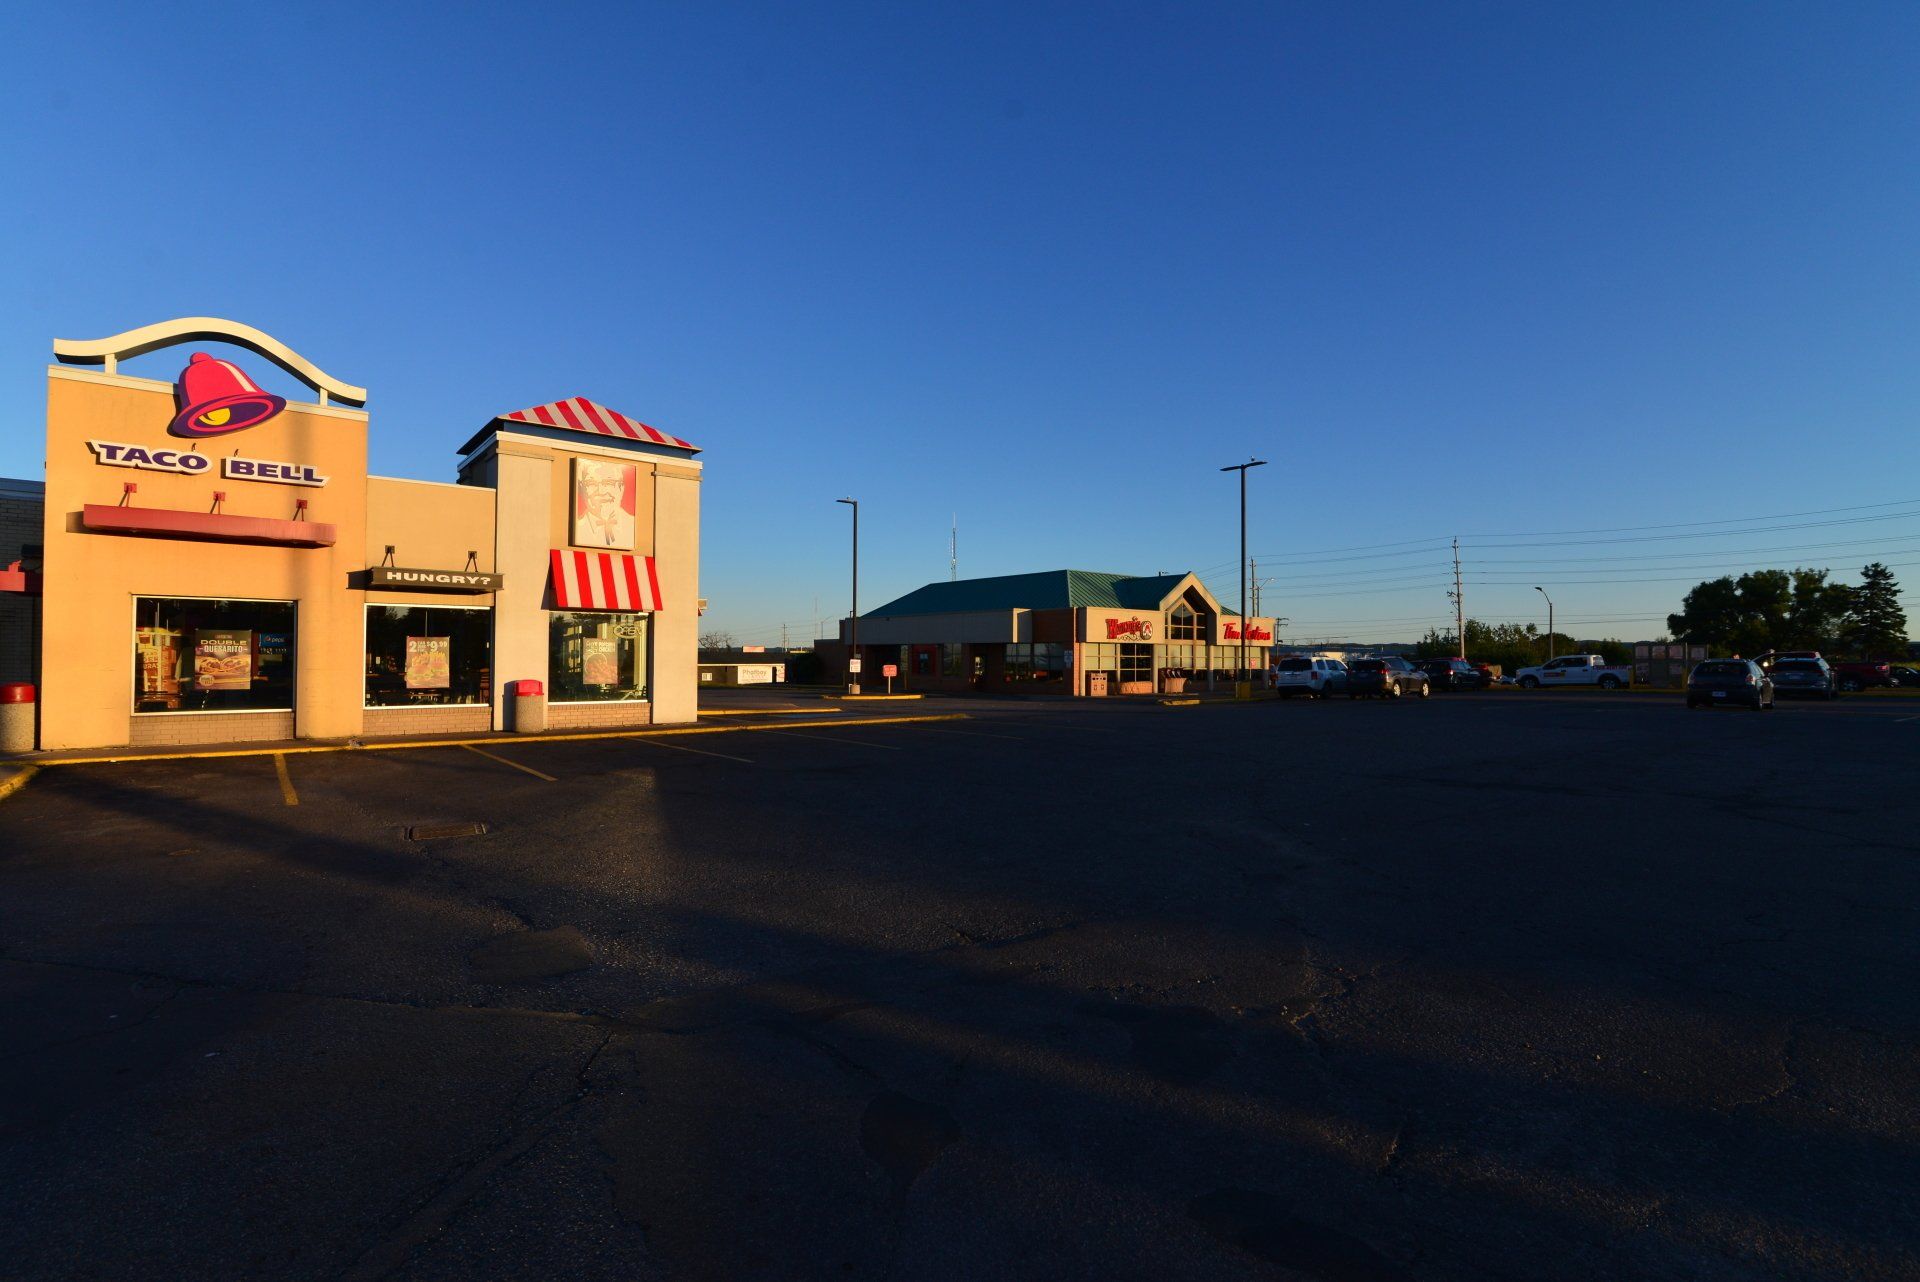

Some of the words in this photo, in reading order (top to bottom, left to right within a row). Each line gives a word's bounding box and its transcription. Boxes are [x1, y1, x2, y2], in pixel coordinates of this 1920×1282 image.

[98, 443, 208, 470] TACO
[230, 459, 324, 483] BELL
[386, 571, 492, 585] HUNGRY?
[1223, 622, 1240, 640] Tim
[204, 645, 243, 653] QUESARITO
[409, 640, 417, 652] 2
